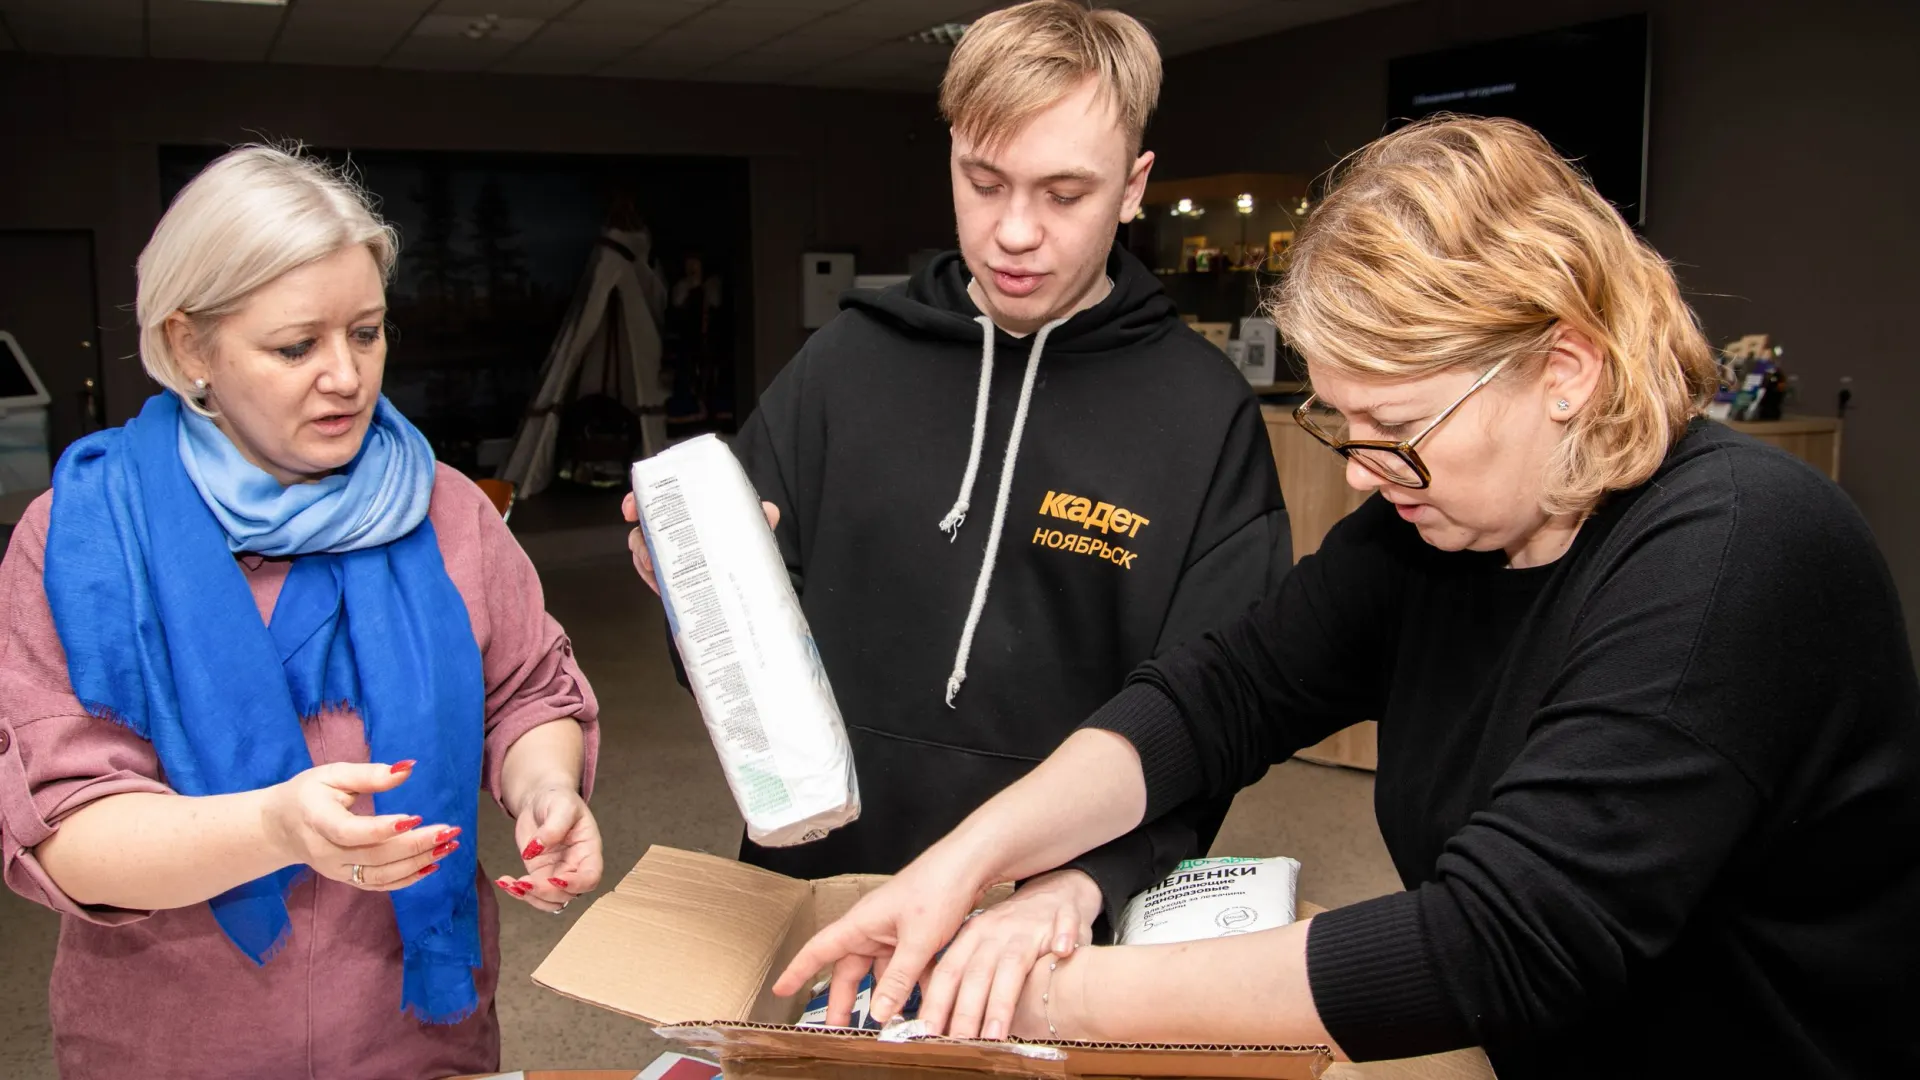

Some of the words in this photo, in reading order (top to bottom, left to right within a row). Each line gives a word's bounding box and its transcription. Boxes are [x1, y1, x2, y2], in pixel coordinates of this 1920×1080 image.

[1032, 527, 1138, 570] НОЯБРЬСК
[1144, 885, 1230, 908] одноразовые
[1145, 879, 1236, 902] впитывающие
[1143, 919, 1154, 933] 5
